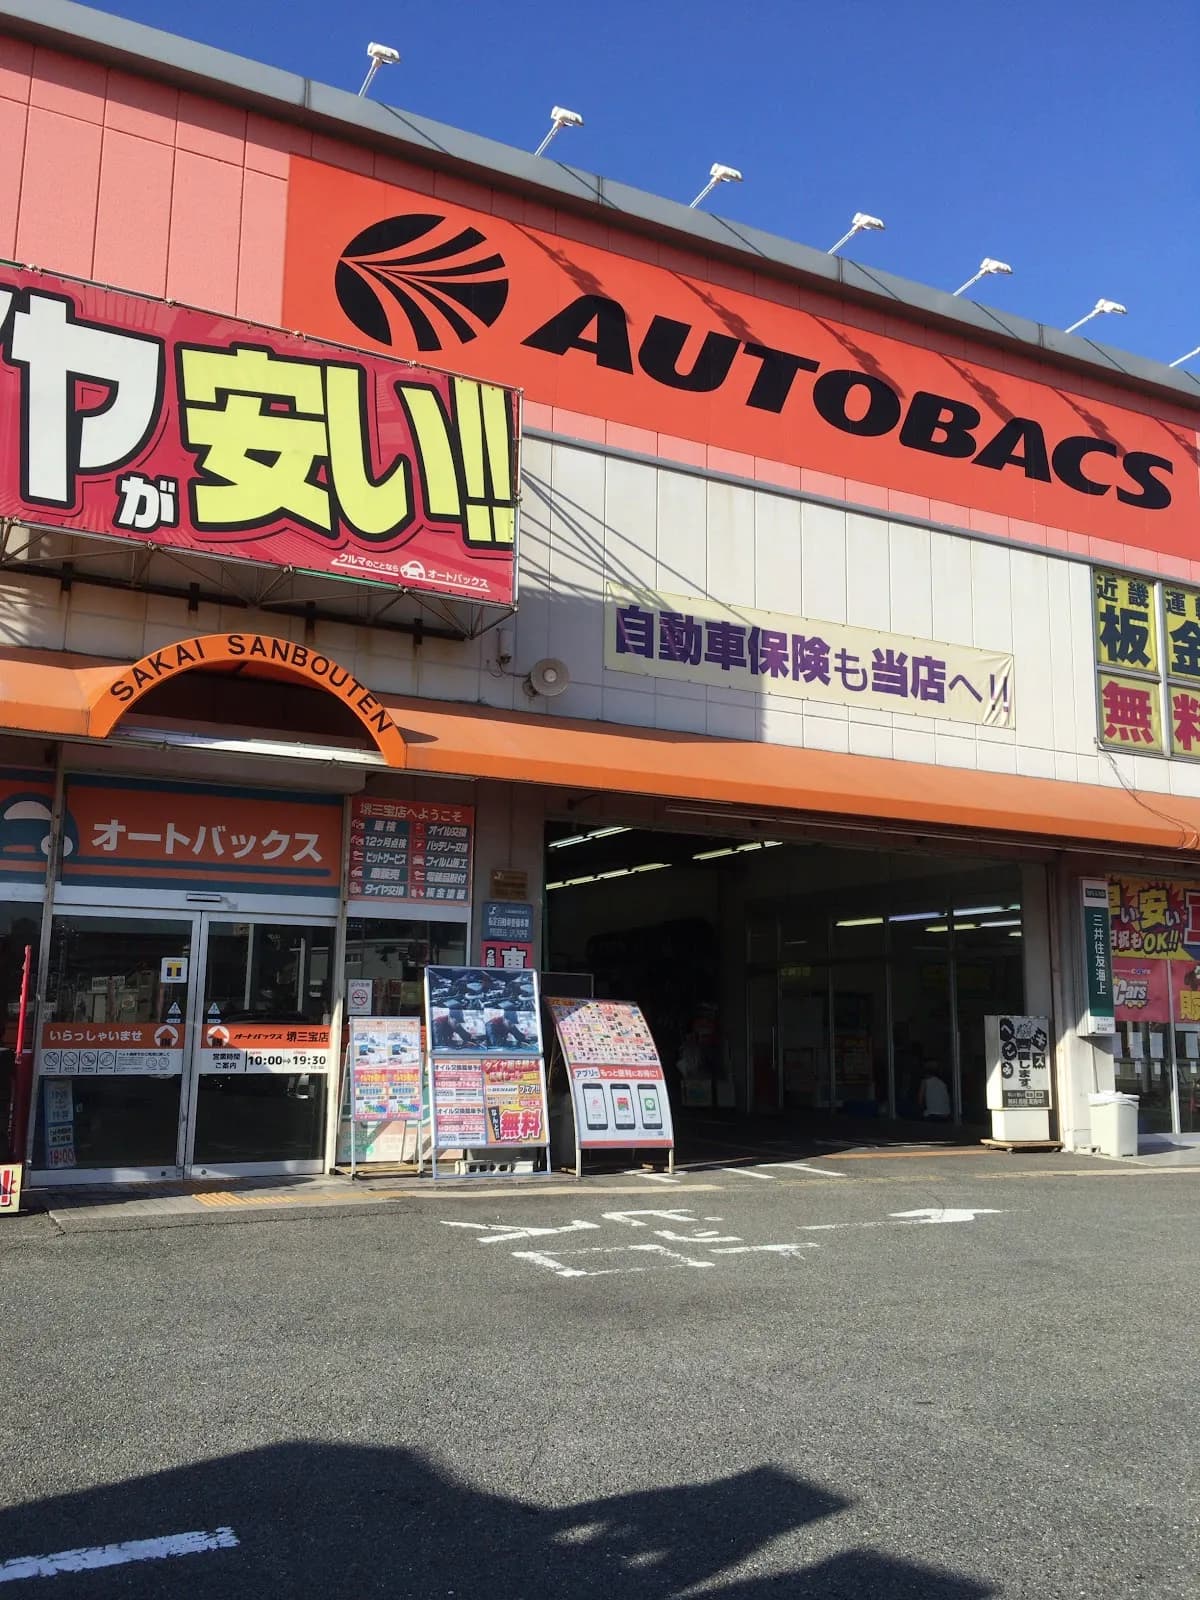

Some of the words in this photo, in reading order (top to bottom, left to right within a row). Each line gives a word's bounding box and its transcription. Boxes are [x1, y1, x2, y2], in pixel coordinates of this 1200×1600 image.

[0, 283, 516, 546] ヤが安い!!
[520, 293, 1173, 510] AUTOBACS
[338, 552, 399, 573] クルマのことなら
[427, 569, 489, 589] オートバックス
[615, 604, 1010, 714] 自動車保険も当店へ!!
[110, 639, 206, 703] SAKAI
[226, 632, 394, 735] SANBOUTEN
[360, 802, 463, 823] 堺三宝店へようこそ
[91, 819, 323, 864] オートバックス
[428, 825, 468, 838] オイル交換
[364, 883, 405, 897] タイヤ交換
[1092, 914, 1107, 995] 三井住友海上
[50, 1030, 143, 1042] いらっしゃいませ
[234, 1032, 283, 1040] オートバックス
[286, 1030, 330, 1043] 堺三宝店
[215, 1062, 237, 1070] ご案内
[248, 1055, 283, 1066] 10:00
[292, 1055, 327, 1065] 19:30
[500, 1109, 541, 1139] 無料
